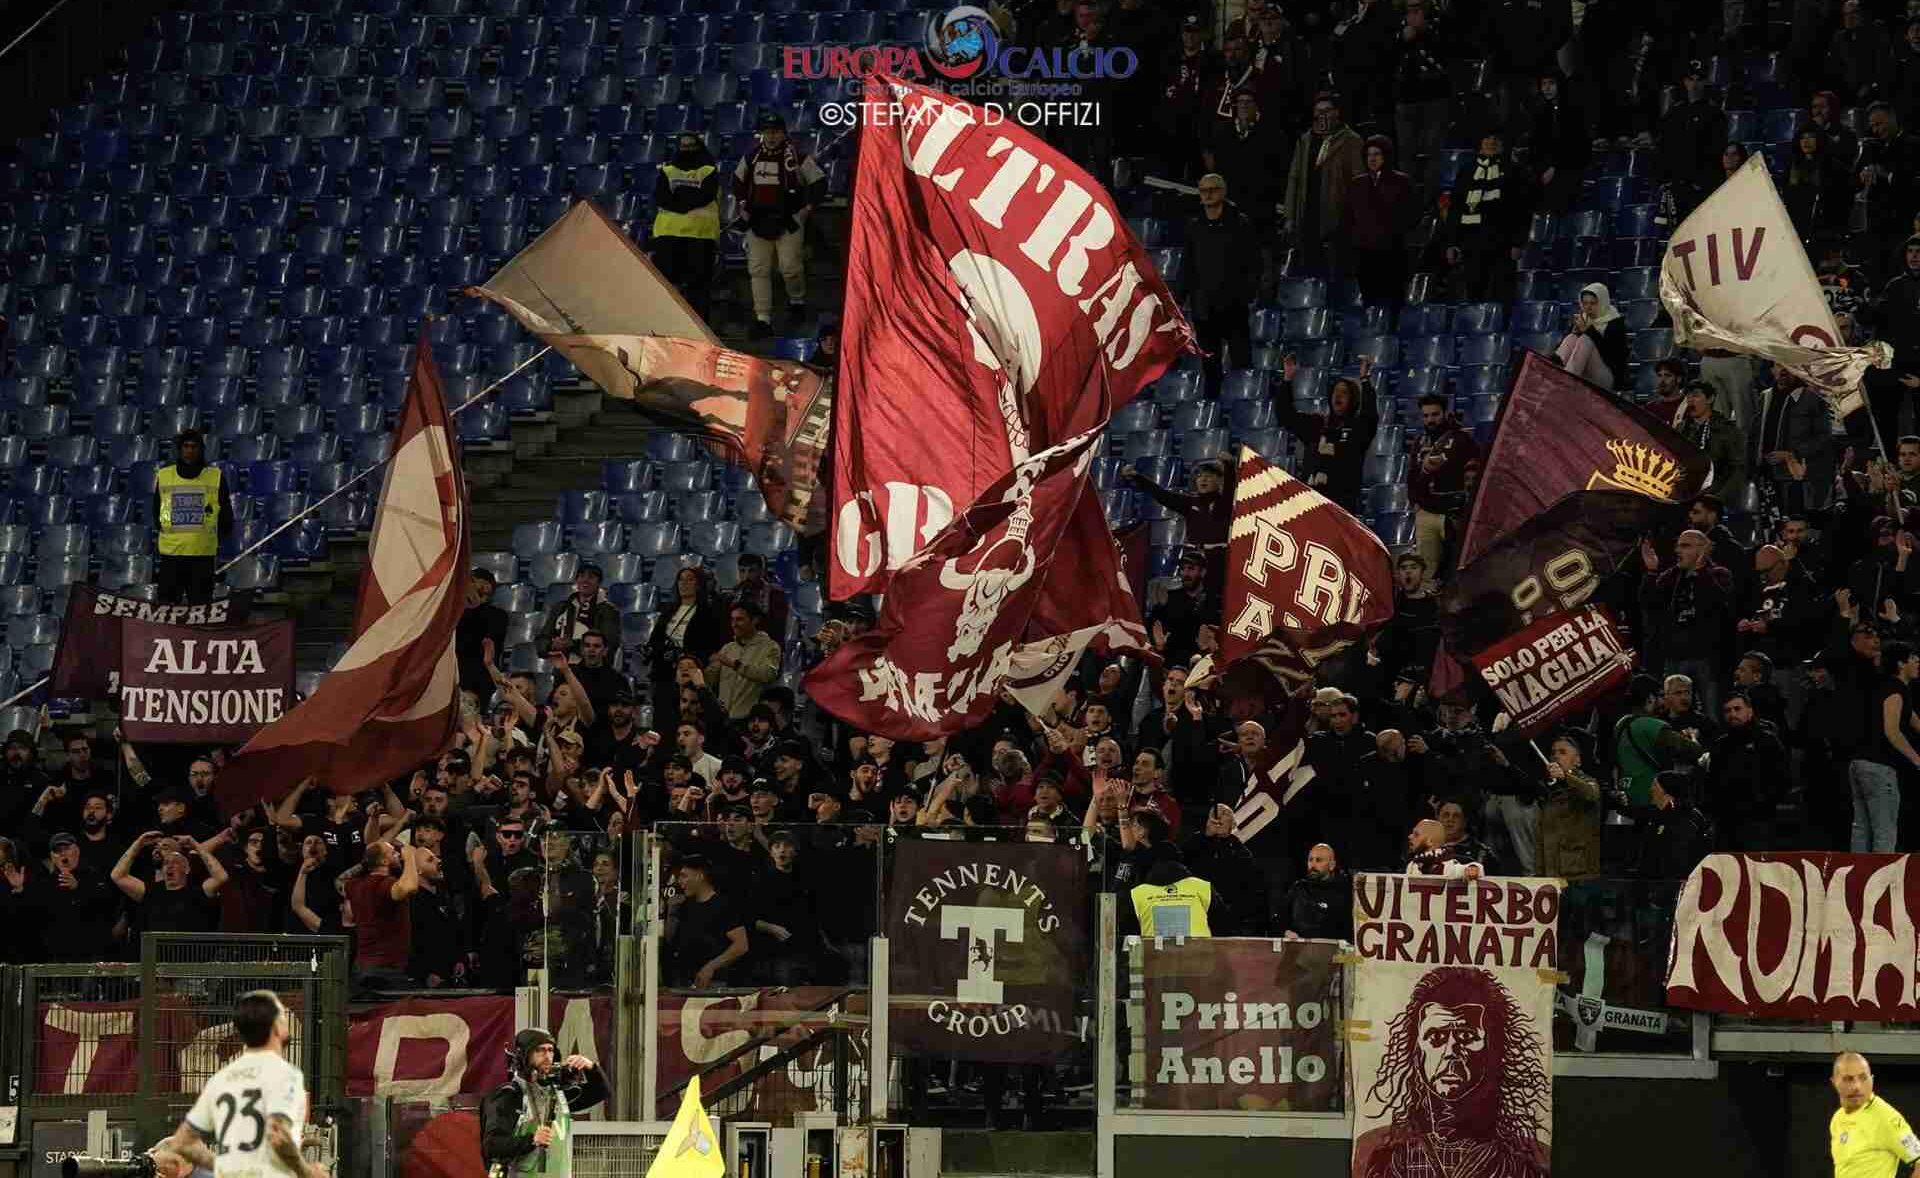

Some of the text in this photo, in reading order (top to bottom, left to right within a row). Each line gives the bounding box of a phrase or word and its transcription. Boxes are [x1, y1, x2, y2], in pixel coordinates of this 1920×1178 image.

[94, 593, 230, 625] SEMPRE
[144, 638, 266, 675] ALTA
[1480, 610, 1609, 686] SOLO PER LA
[1495, 635, 1615, 717] MAGLIA
[121, 685, 284, 725] TENSIONE
[904, 862, 1060, 934] TENNENT'S
[1355, 875, 1558, 925] VITERBO
[1356, 921, 1557, 968] GRANATA
[927, 1000, 1028, 1038] GROUP
[1160, 992, 1324, 1030] Primo
[1604, 1011, 1661, 1030] GRANATA
[1156, 1046, 1327, 1085] Anello
[216, 1088, 264, 1154] 23
